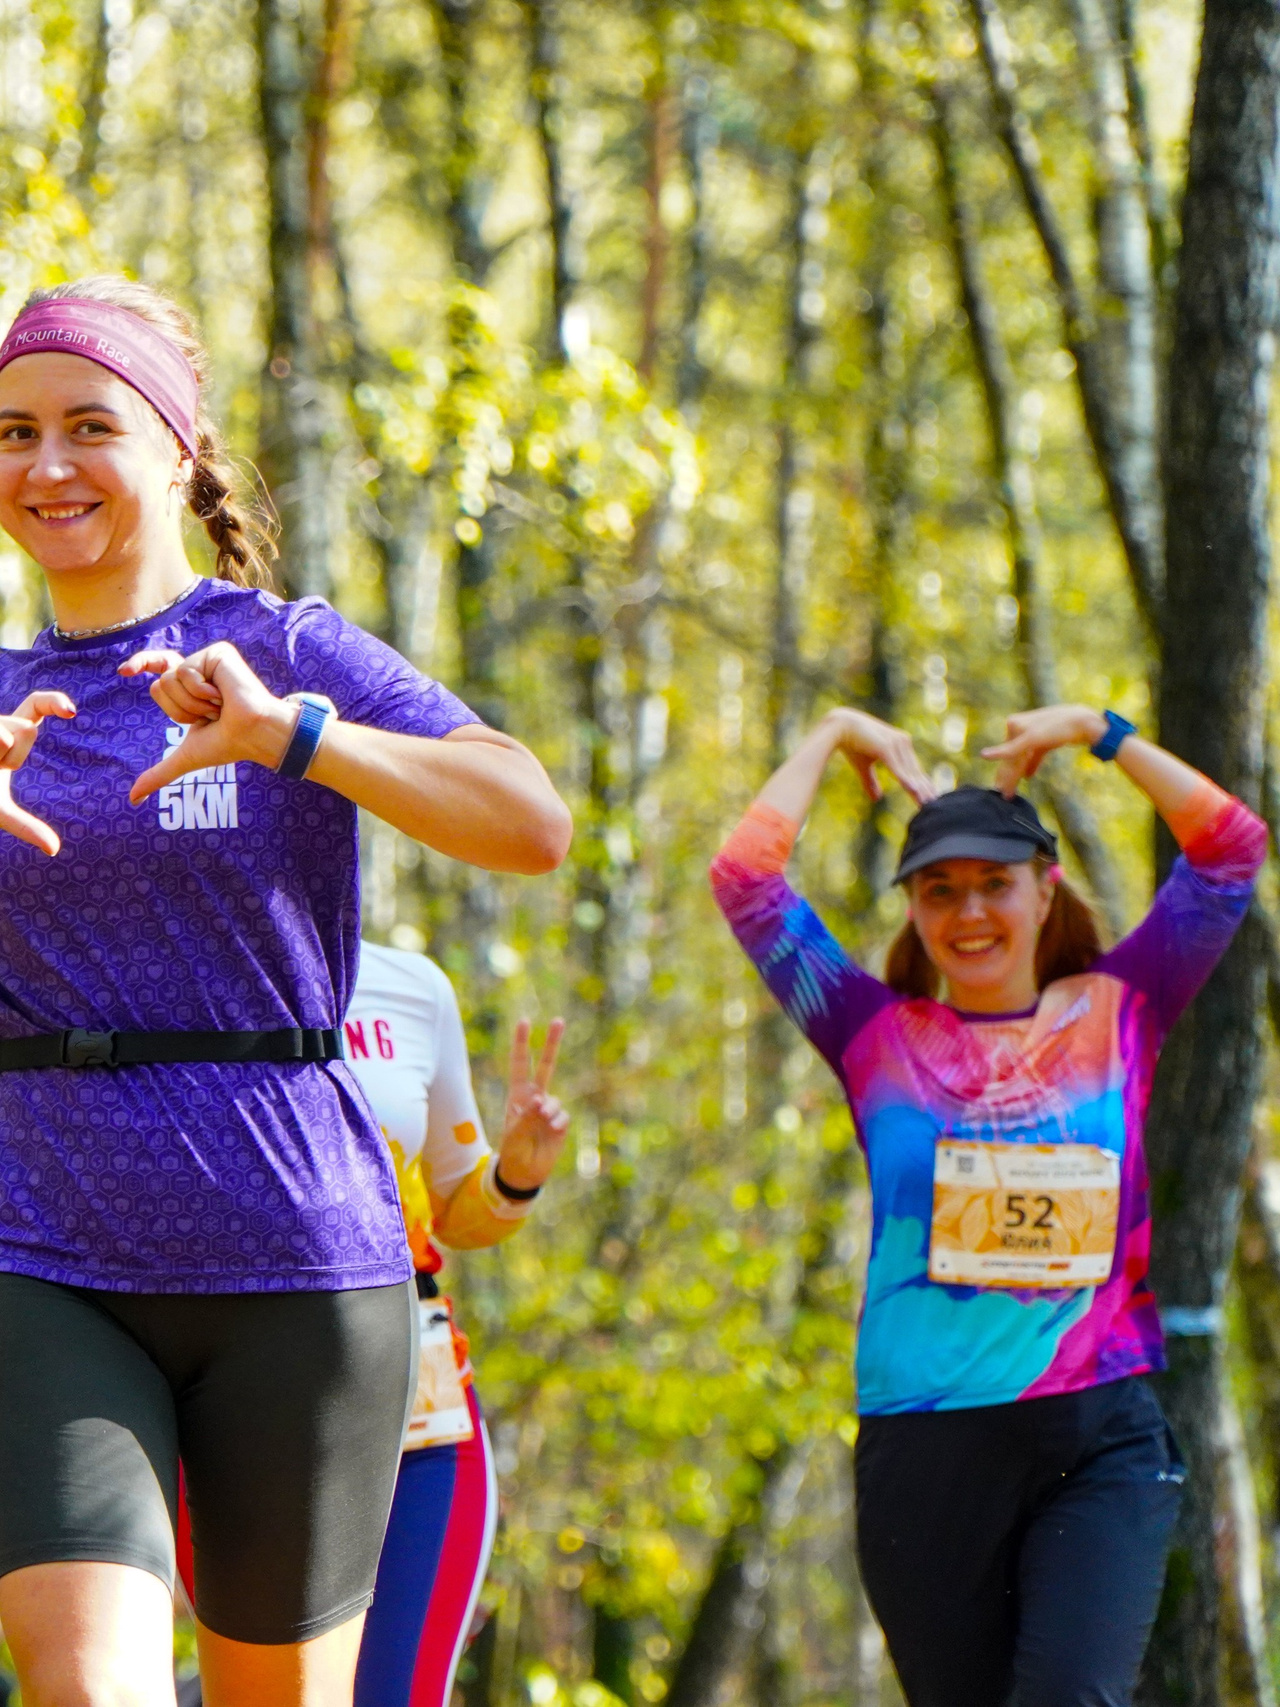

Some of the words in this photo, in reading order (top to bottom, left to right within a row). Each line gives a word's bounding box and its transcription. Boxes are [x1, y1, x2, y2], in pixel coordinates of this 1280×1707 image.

[15, 328, 88, 346] Mountain
[97, 338, 131, 368] Race
[158, 783, 238, 830] 5KM
[1005, 1195, 1053, 1228] 52
